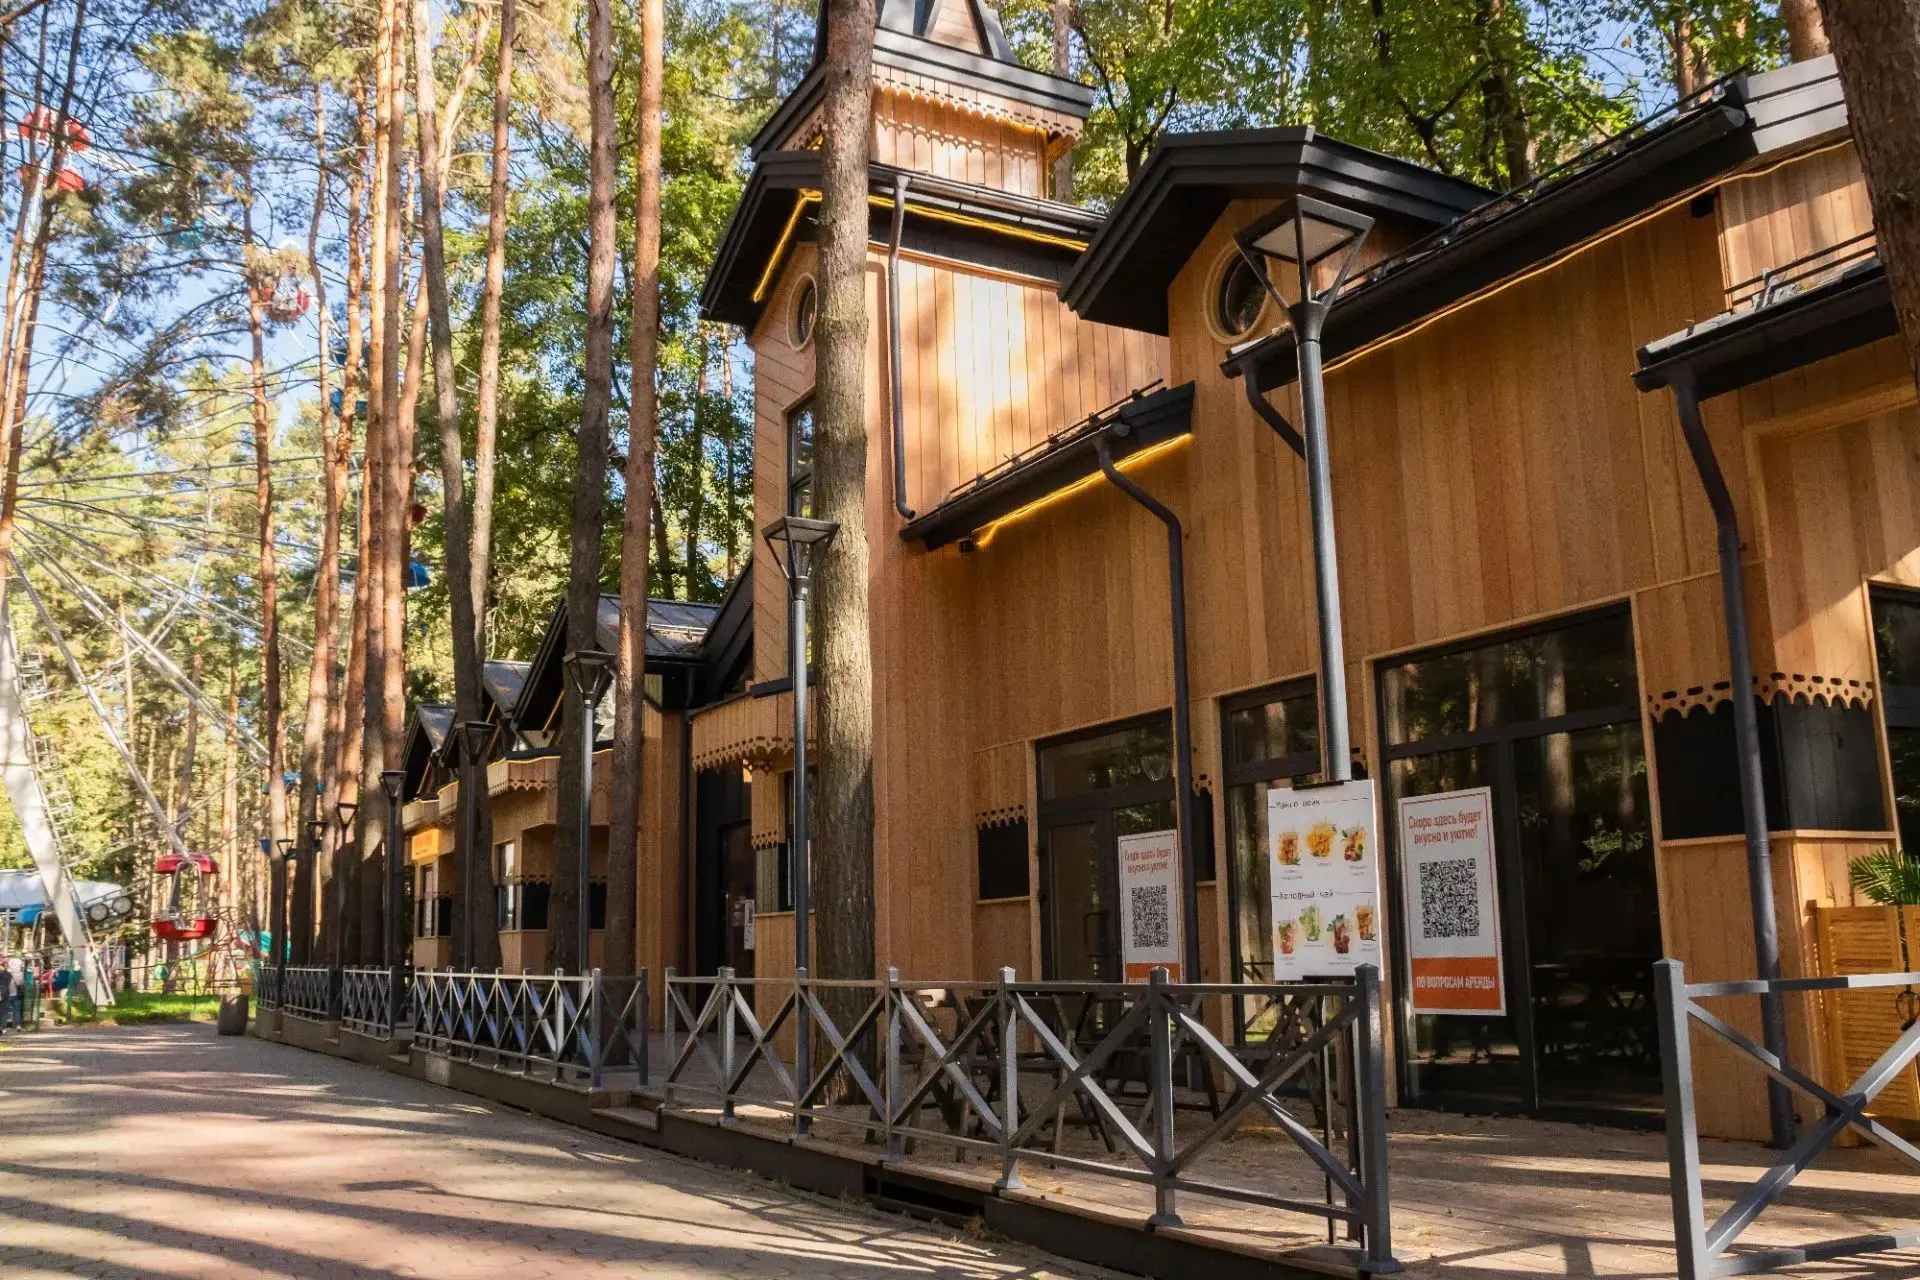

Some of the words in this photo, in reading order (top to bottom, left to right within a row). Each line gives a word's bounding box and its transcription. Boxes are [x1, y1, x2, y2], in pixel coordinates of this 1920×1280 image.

[1408, 815, 1432, 831] Скоро
[1433, 815, 1457, 826] здесь
[1458, 810, 1481, 826] будет
[1414, 832, 1441, 847] вкусно
[1443, 831, 1449, 841] и
[1450, 824, 1478, 844] уютно!
[1279, 890, 1315, 900] Холодный
[1416, 976, 1426, 988] ПО
[1427, 976, 1464, 988] ВОПРОСАМ
[1465, 976, 1496, 989] АРЕНДЫ
